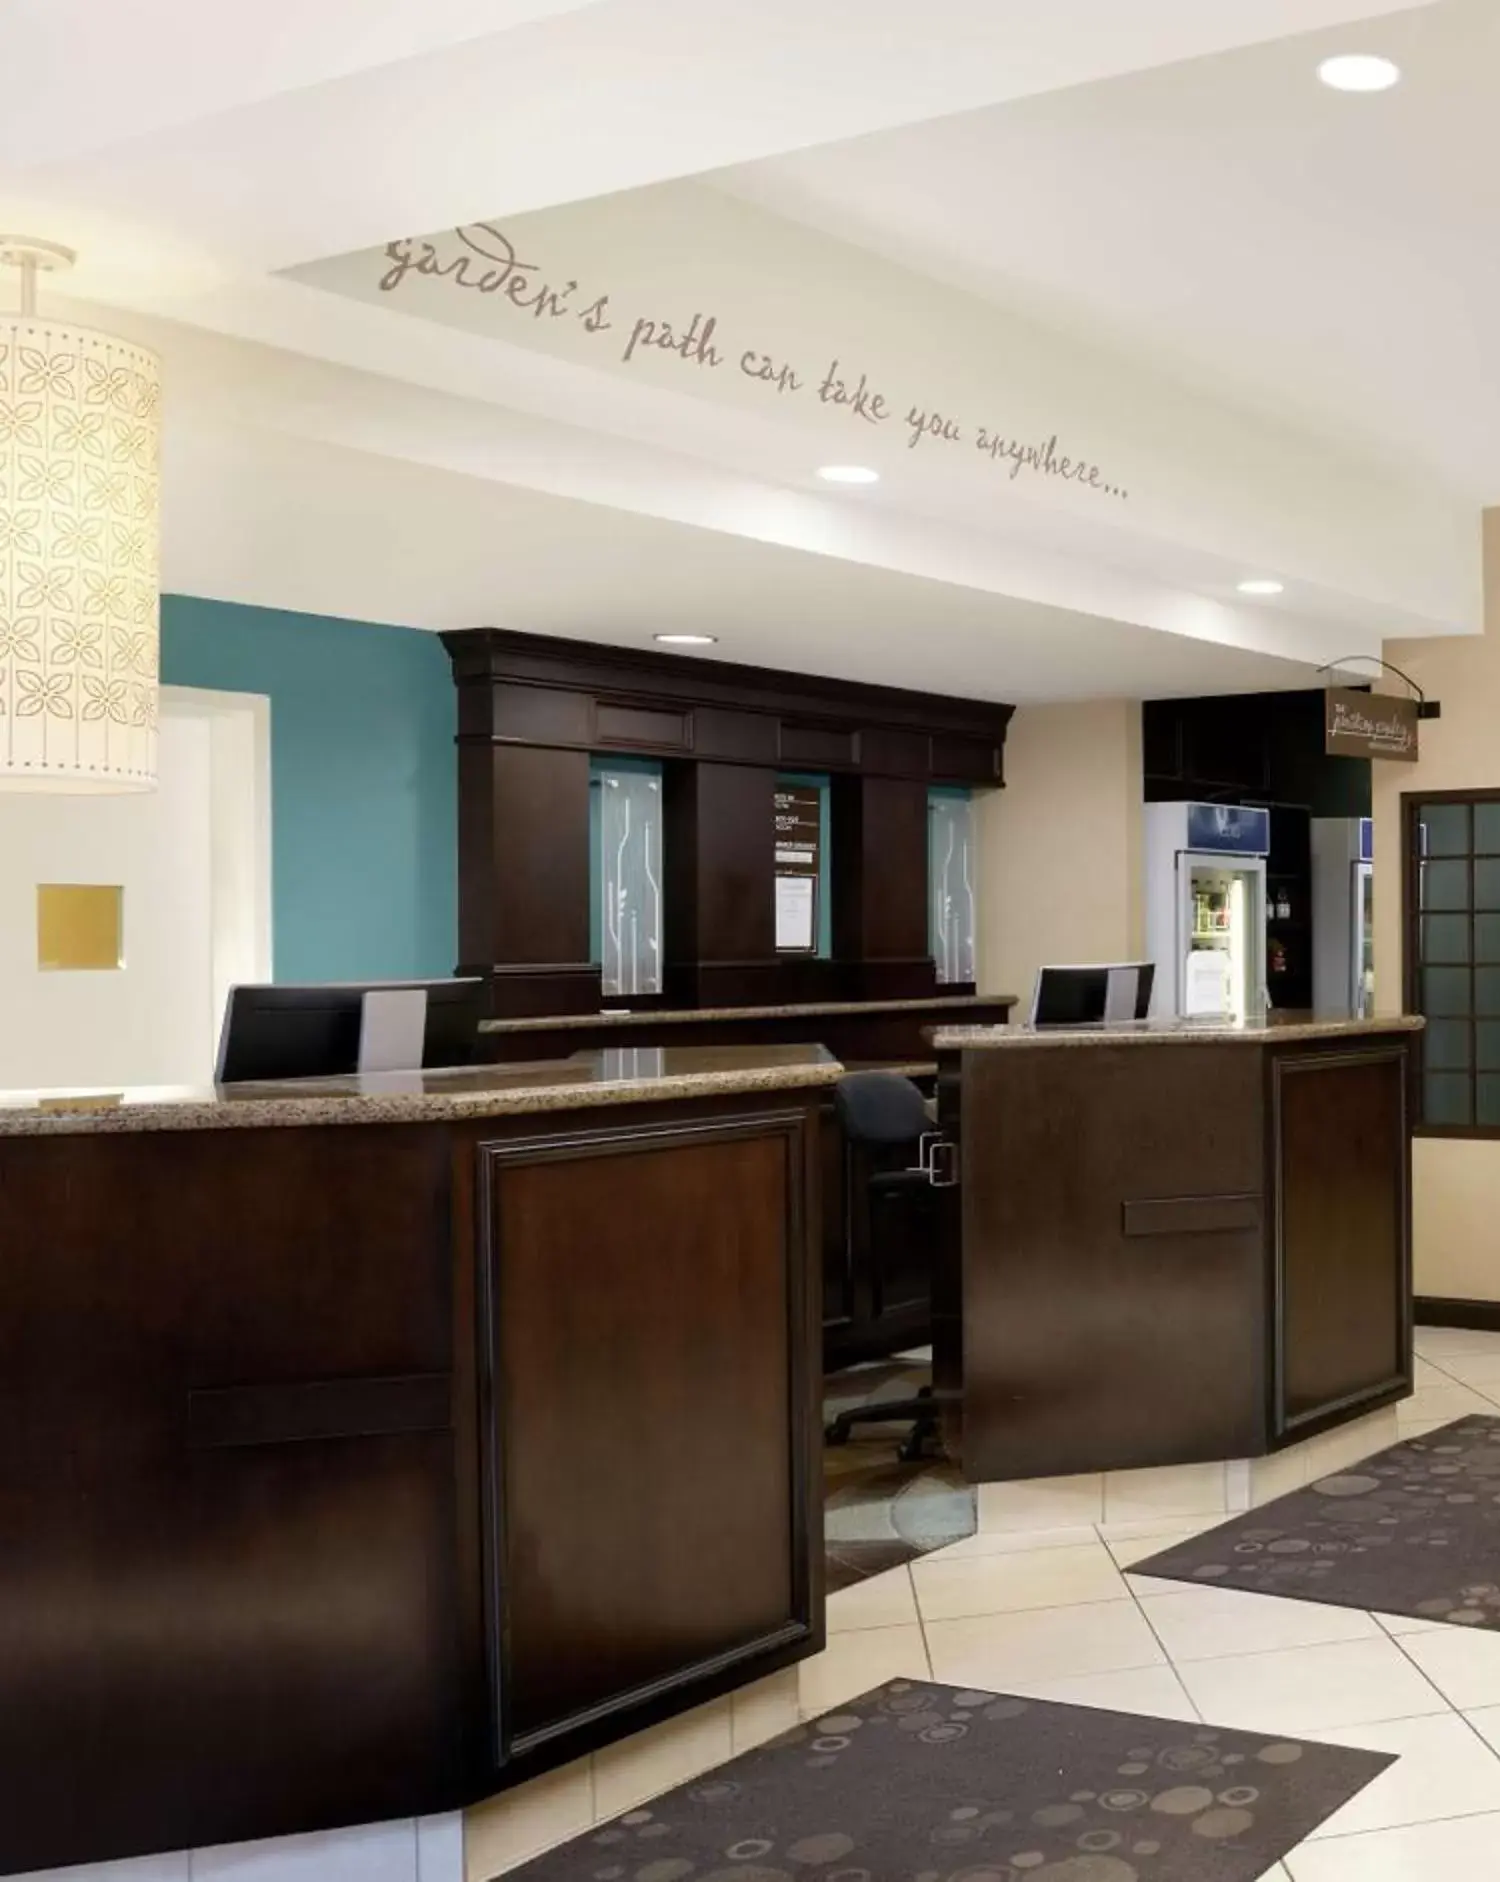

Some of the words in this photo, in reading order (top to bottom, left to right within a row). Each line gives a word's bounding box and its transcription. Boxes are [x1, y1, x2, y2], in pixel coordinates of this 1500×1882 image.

[379, 223, 611, 332] garden's
[622, 312, 724, 367] path
[740, 350, 802, 393] can
[818, 360, 889, 424] take
[904, 406, 961, 449] you
[976, 427, 1129, 500] anywhere...
